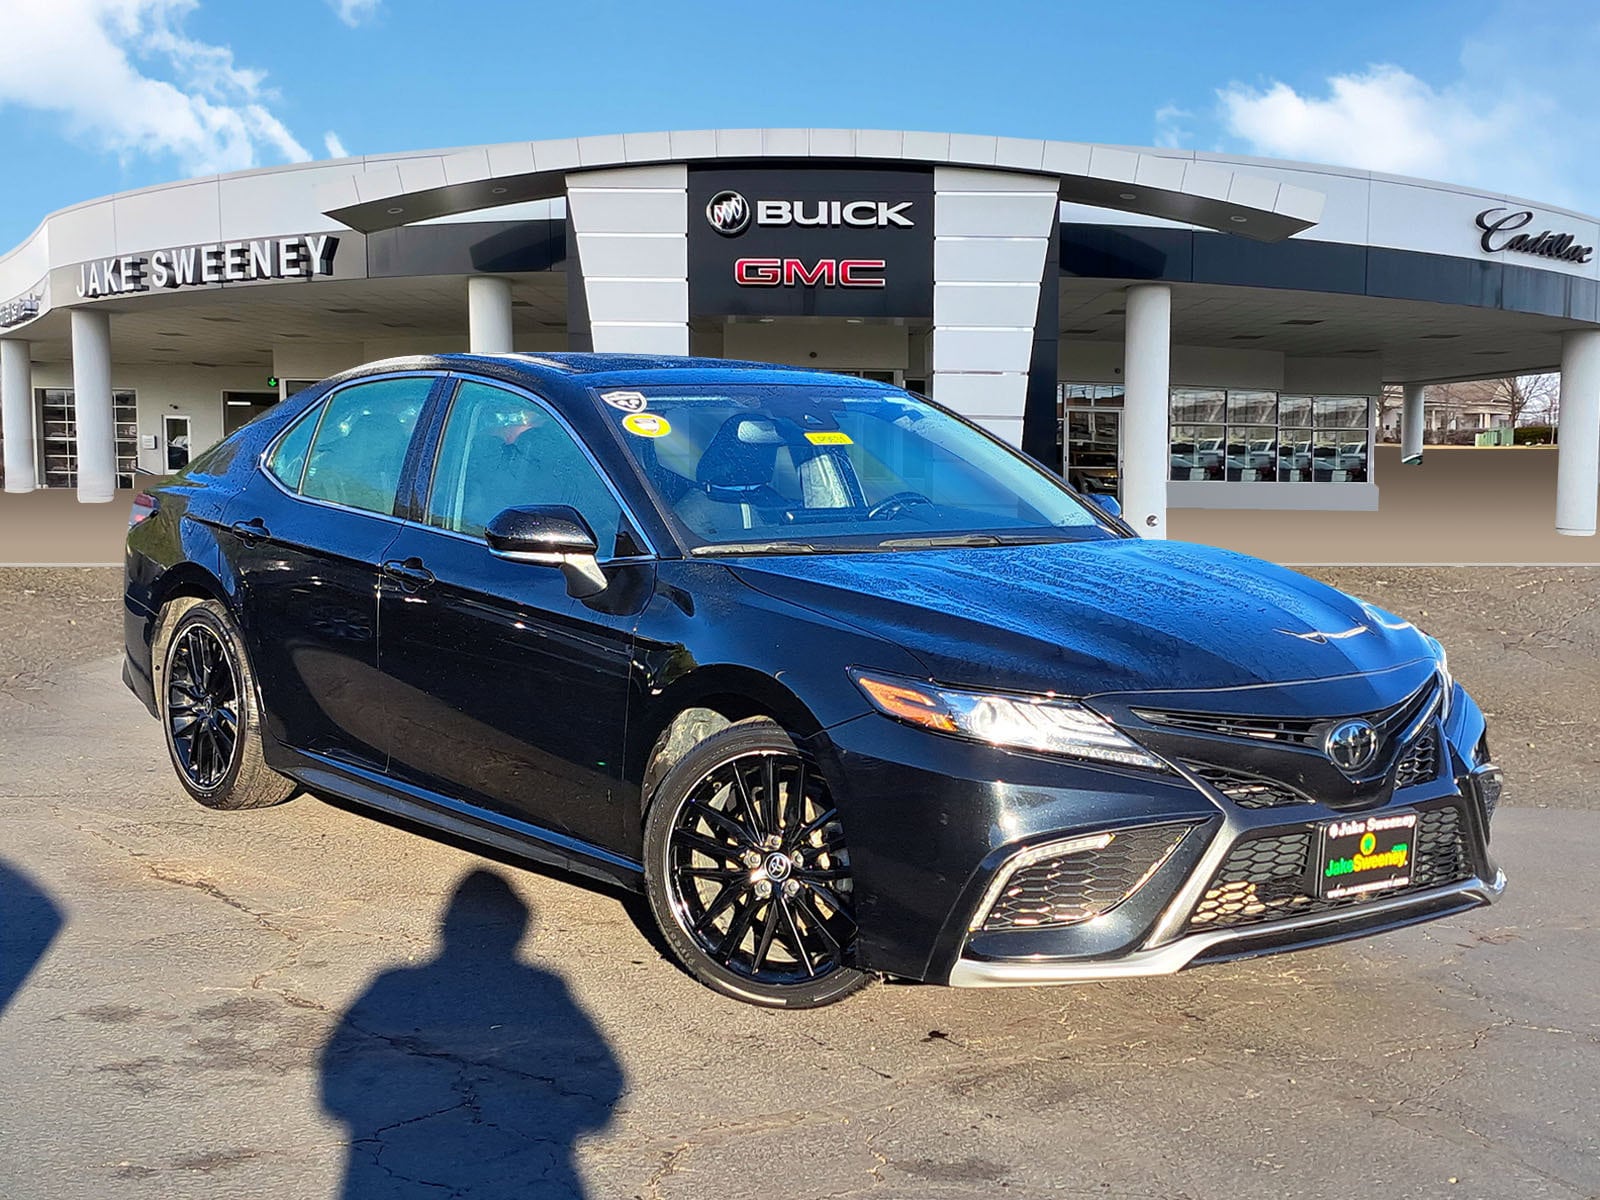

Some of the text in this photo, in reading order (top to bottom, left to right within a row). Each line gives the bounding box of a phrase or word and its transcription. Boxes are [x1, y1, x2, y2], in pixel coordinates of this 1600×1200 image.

[757, 200, 914, 226] BUICK
[1475, 207, 1593, 263] Cadillac
[77, 235, 337, 298] JAKE SWEENEY
[735, 258, 886, 286] GMC
[1338, 820, 1365, 836] Jake
